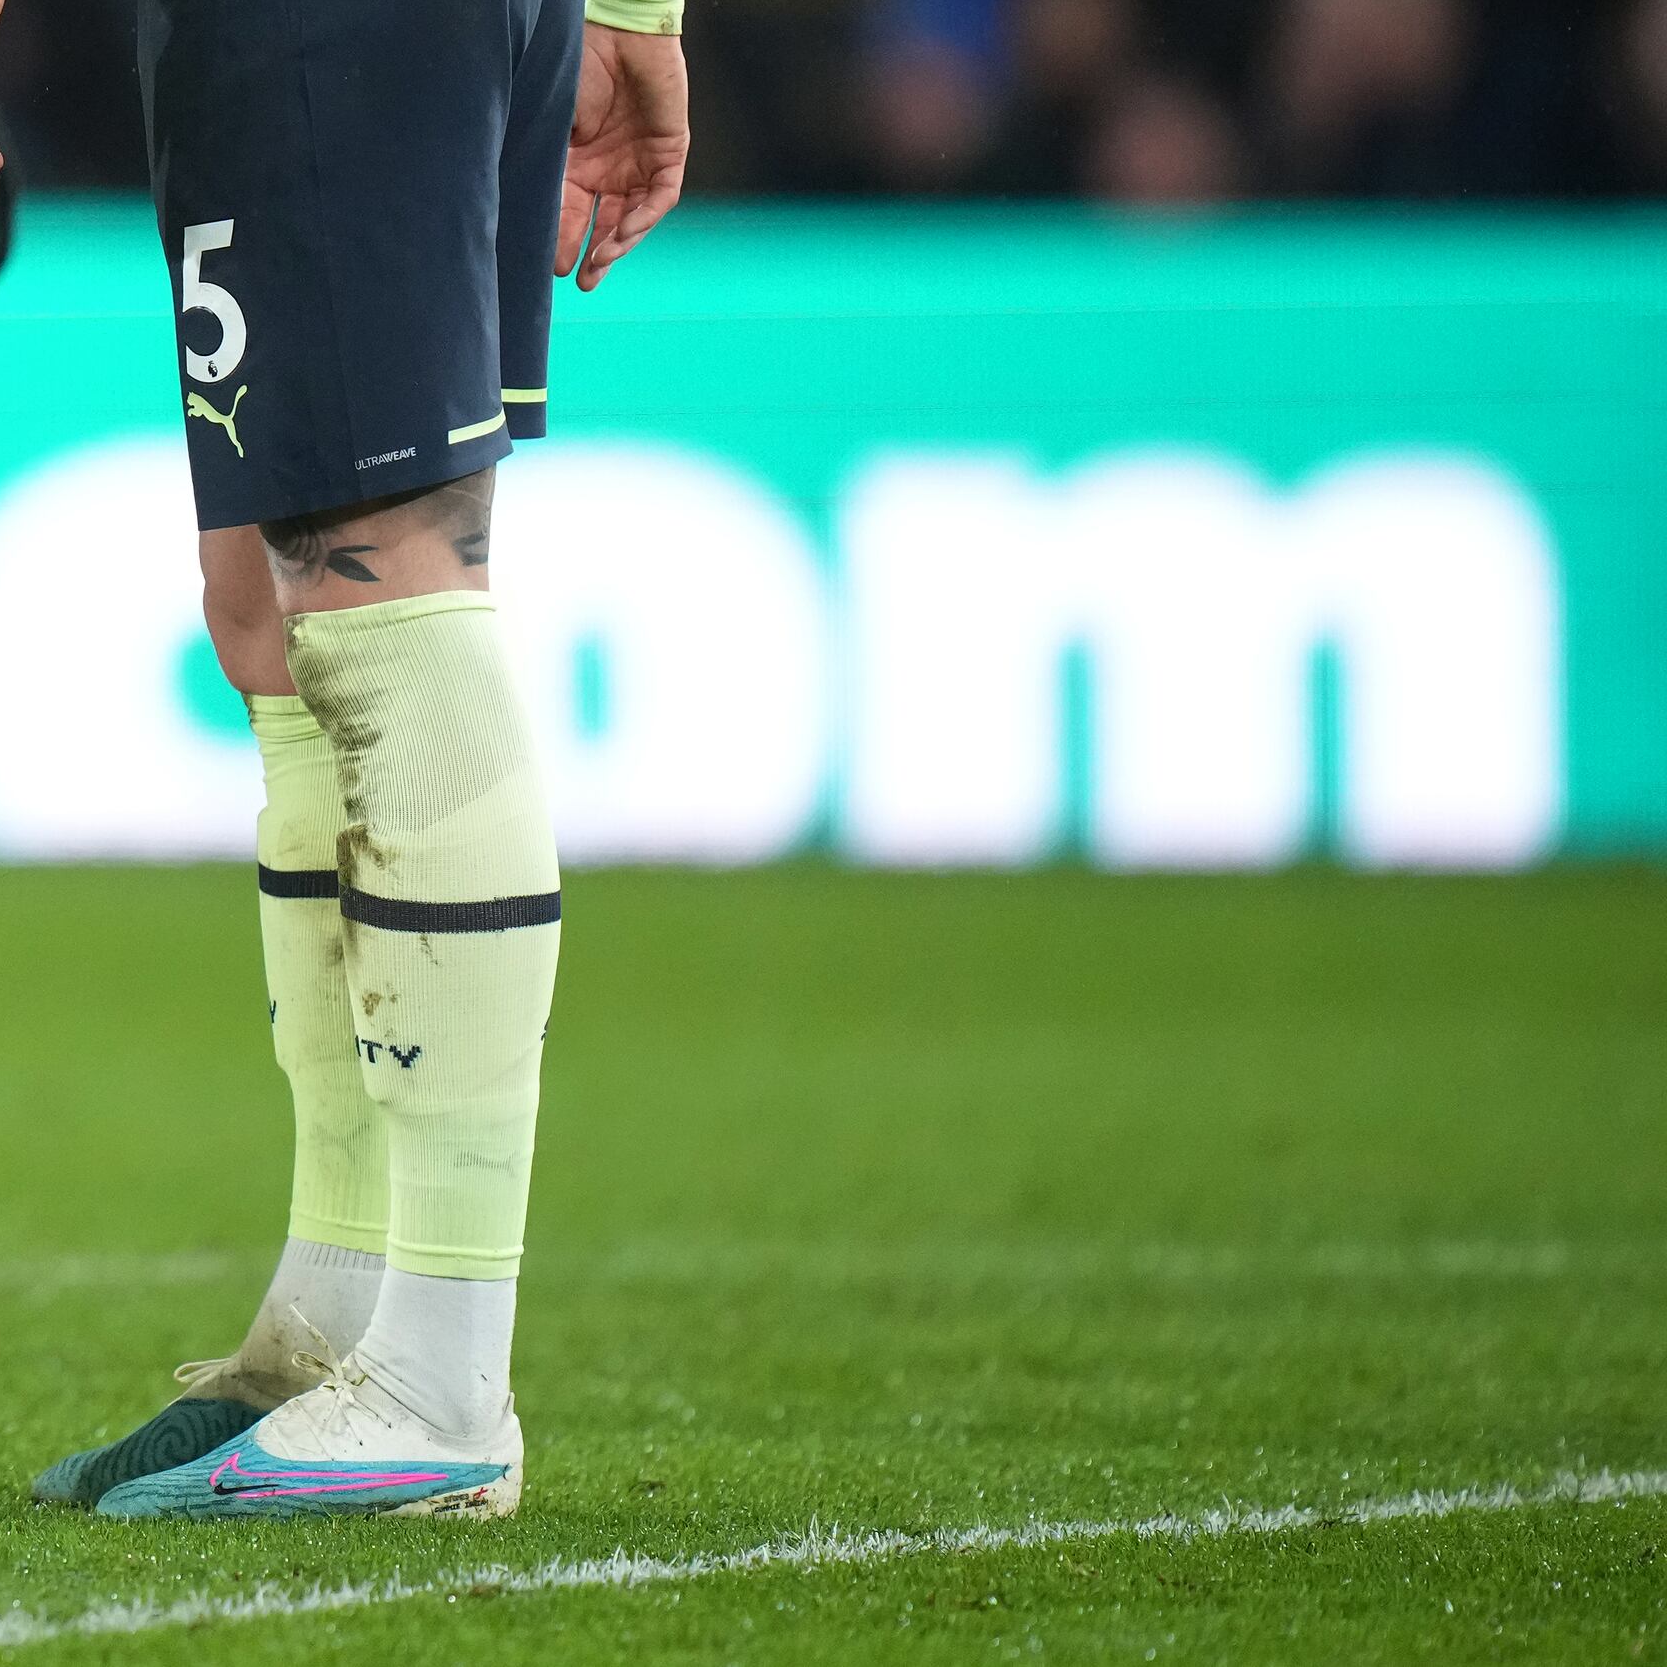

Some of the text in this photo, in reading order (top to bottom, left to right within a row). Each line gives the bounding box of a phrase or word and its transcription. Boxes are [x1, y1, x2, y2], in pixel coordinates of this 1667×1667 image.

[181, 218, 247, 384] 5
[354, 446, 417, 471] ULTRAWEAVE
[355, 1034, 421, 1069] ITY
